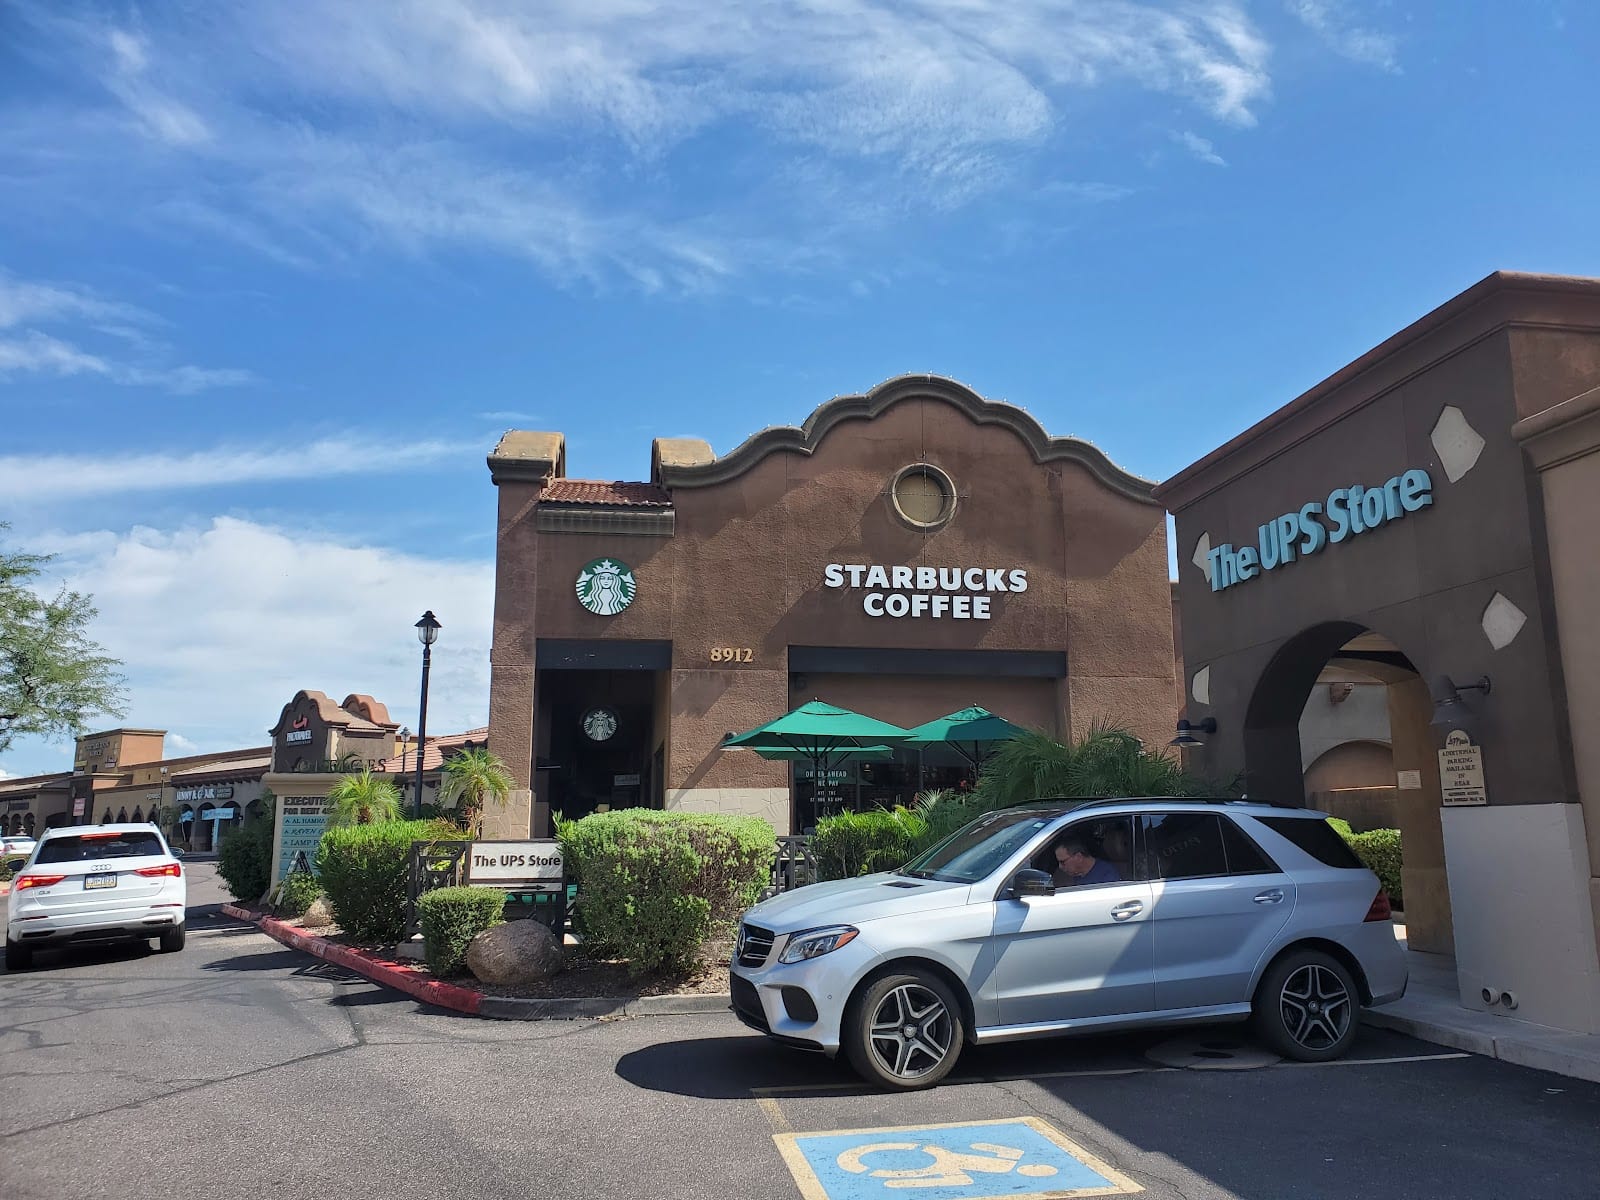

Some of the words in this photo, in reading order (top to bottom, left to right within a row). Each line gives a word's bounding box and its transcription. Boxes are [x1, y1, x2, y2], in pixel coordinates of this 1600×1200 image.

[1207, 543, 1260, 592] The
[1258, 502, 1326, 570] UPS
[1326, 469, 1433, 543] Store
[824, 563, 1028, 593] STARBUCKS
[863, 593, 991, 620] COFFEE
[710, 648, 753, 662] 8912
[474, 855, 497, 867] The
[500, 855, 526, 867] UPS
[528, 854, 561, 867] Store
